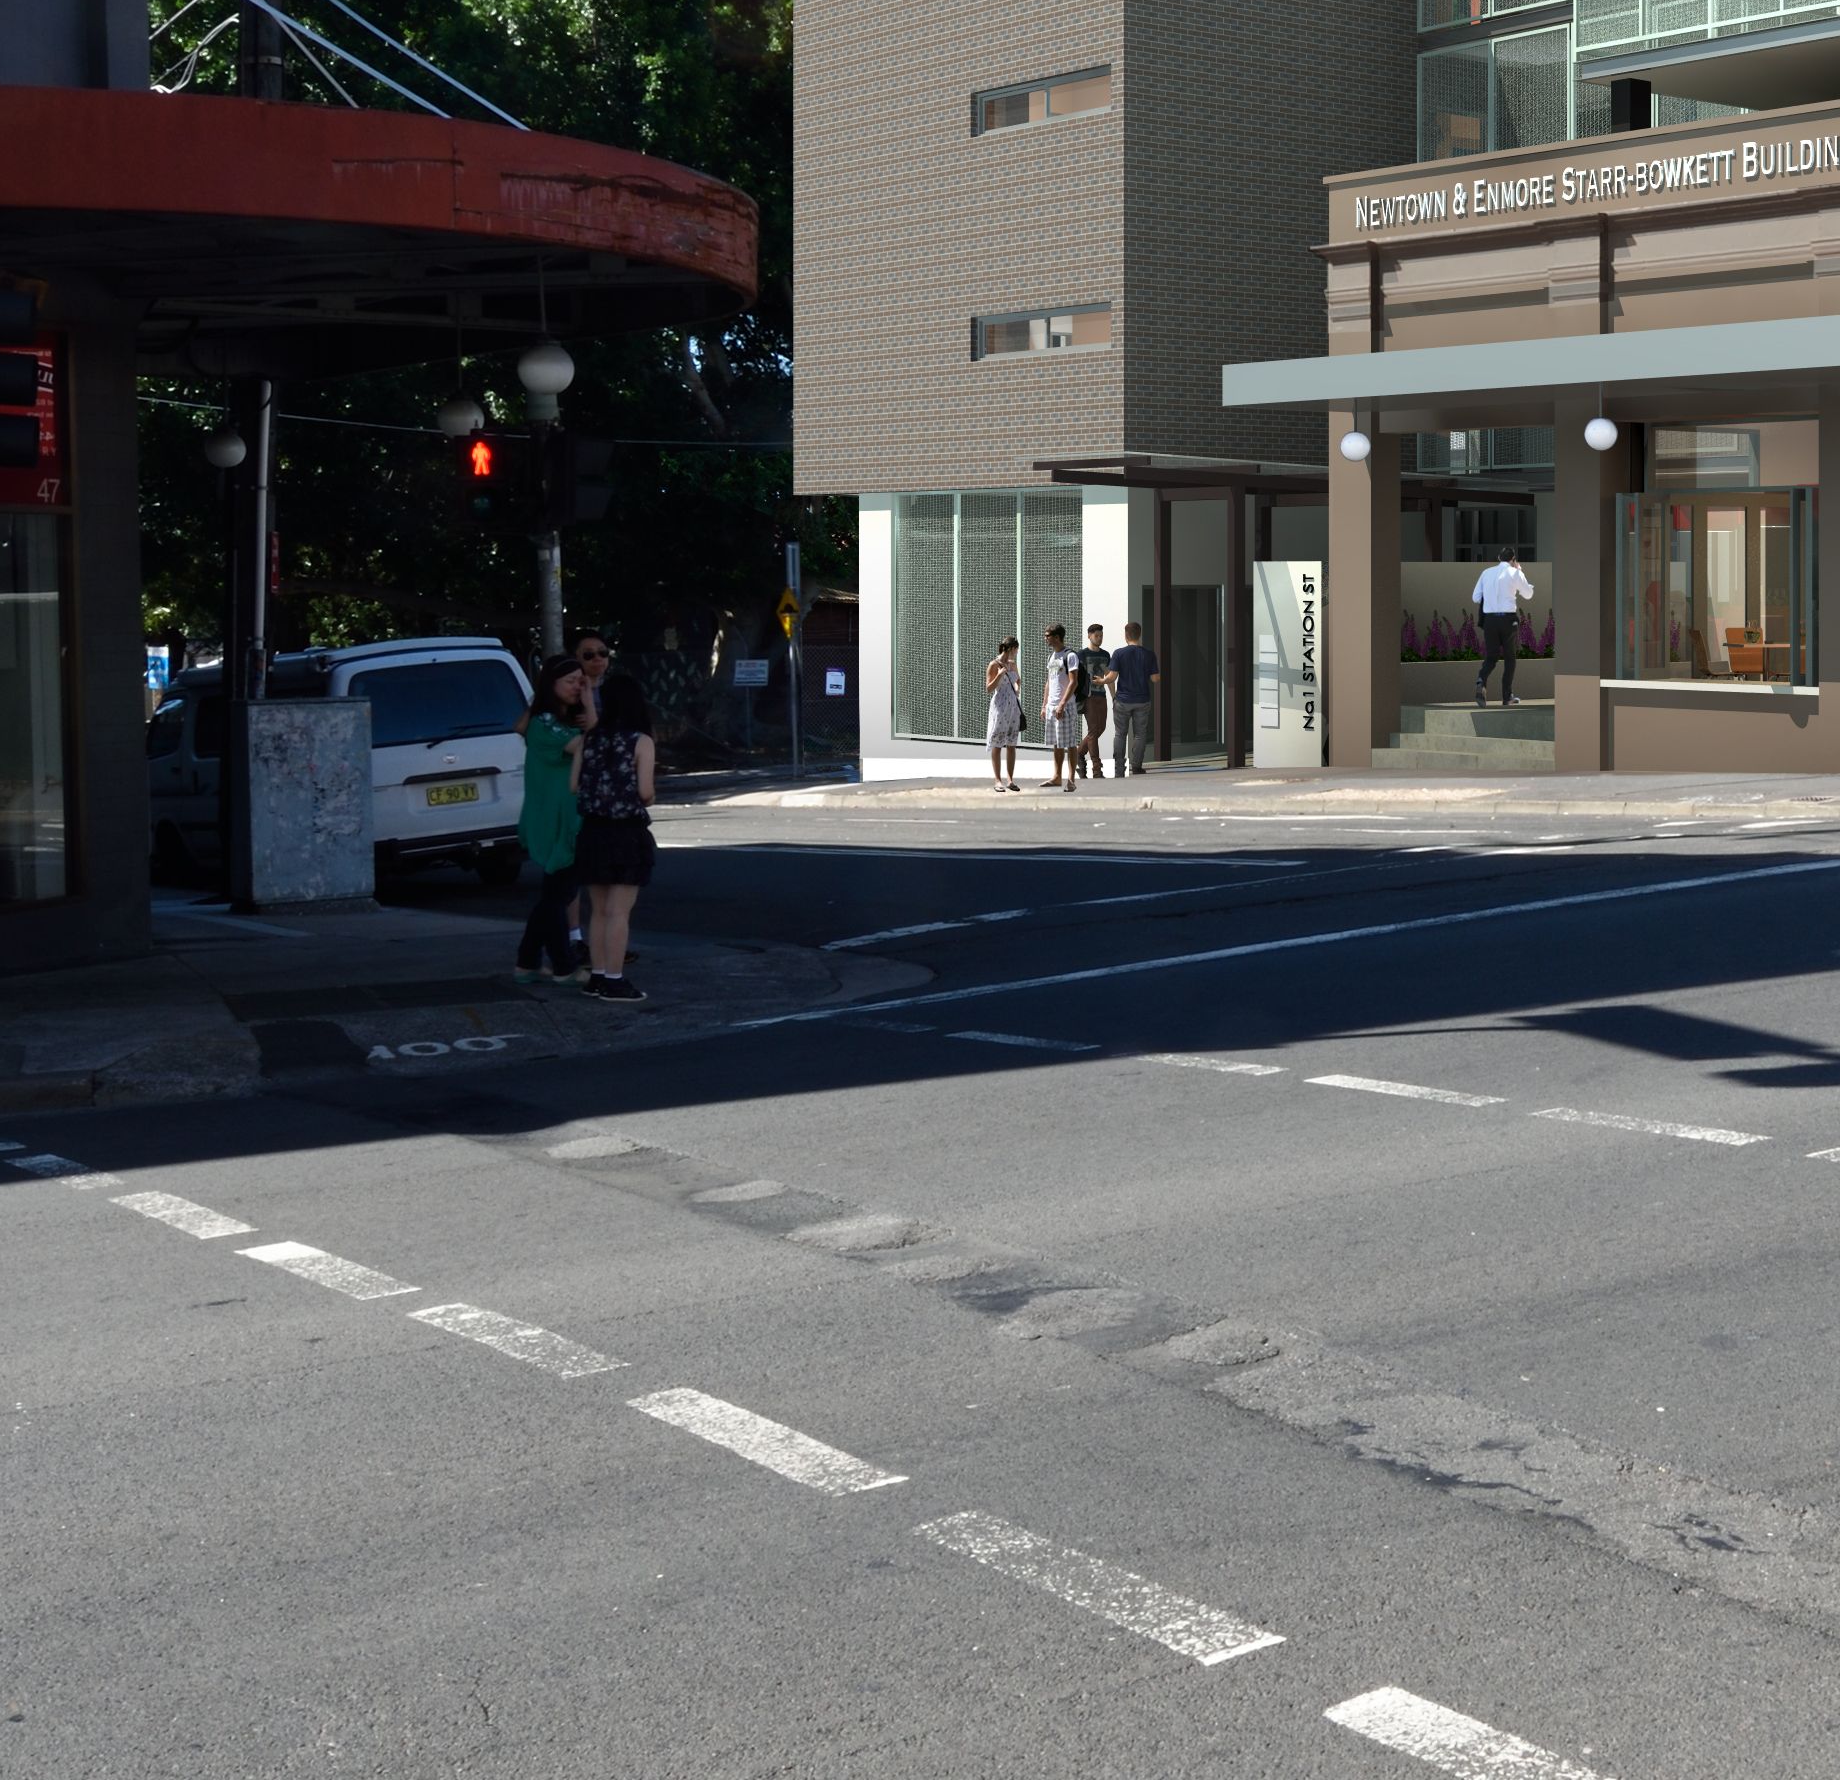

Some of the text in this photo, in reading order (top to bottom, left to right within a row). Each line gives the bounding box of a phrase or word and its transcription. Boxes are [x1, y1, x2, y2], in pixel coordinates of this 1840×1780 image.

[1355, 189, 1447, 229] NEWTOWN
[1452, 181, 1467, 215] &
[1473, 174, 1555, 215] ENMORE
[36, 478, 61, 504] 47
[1302, 573, 1315, 594] ST
[1302, 600, 1315, 682] STATION
